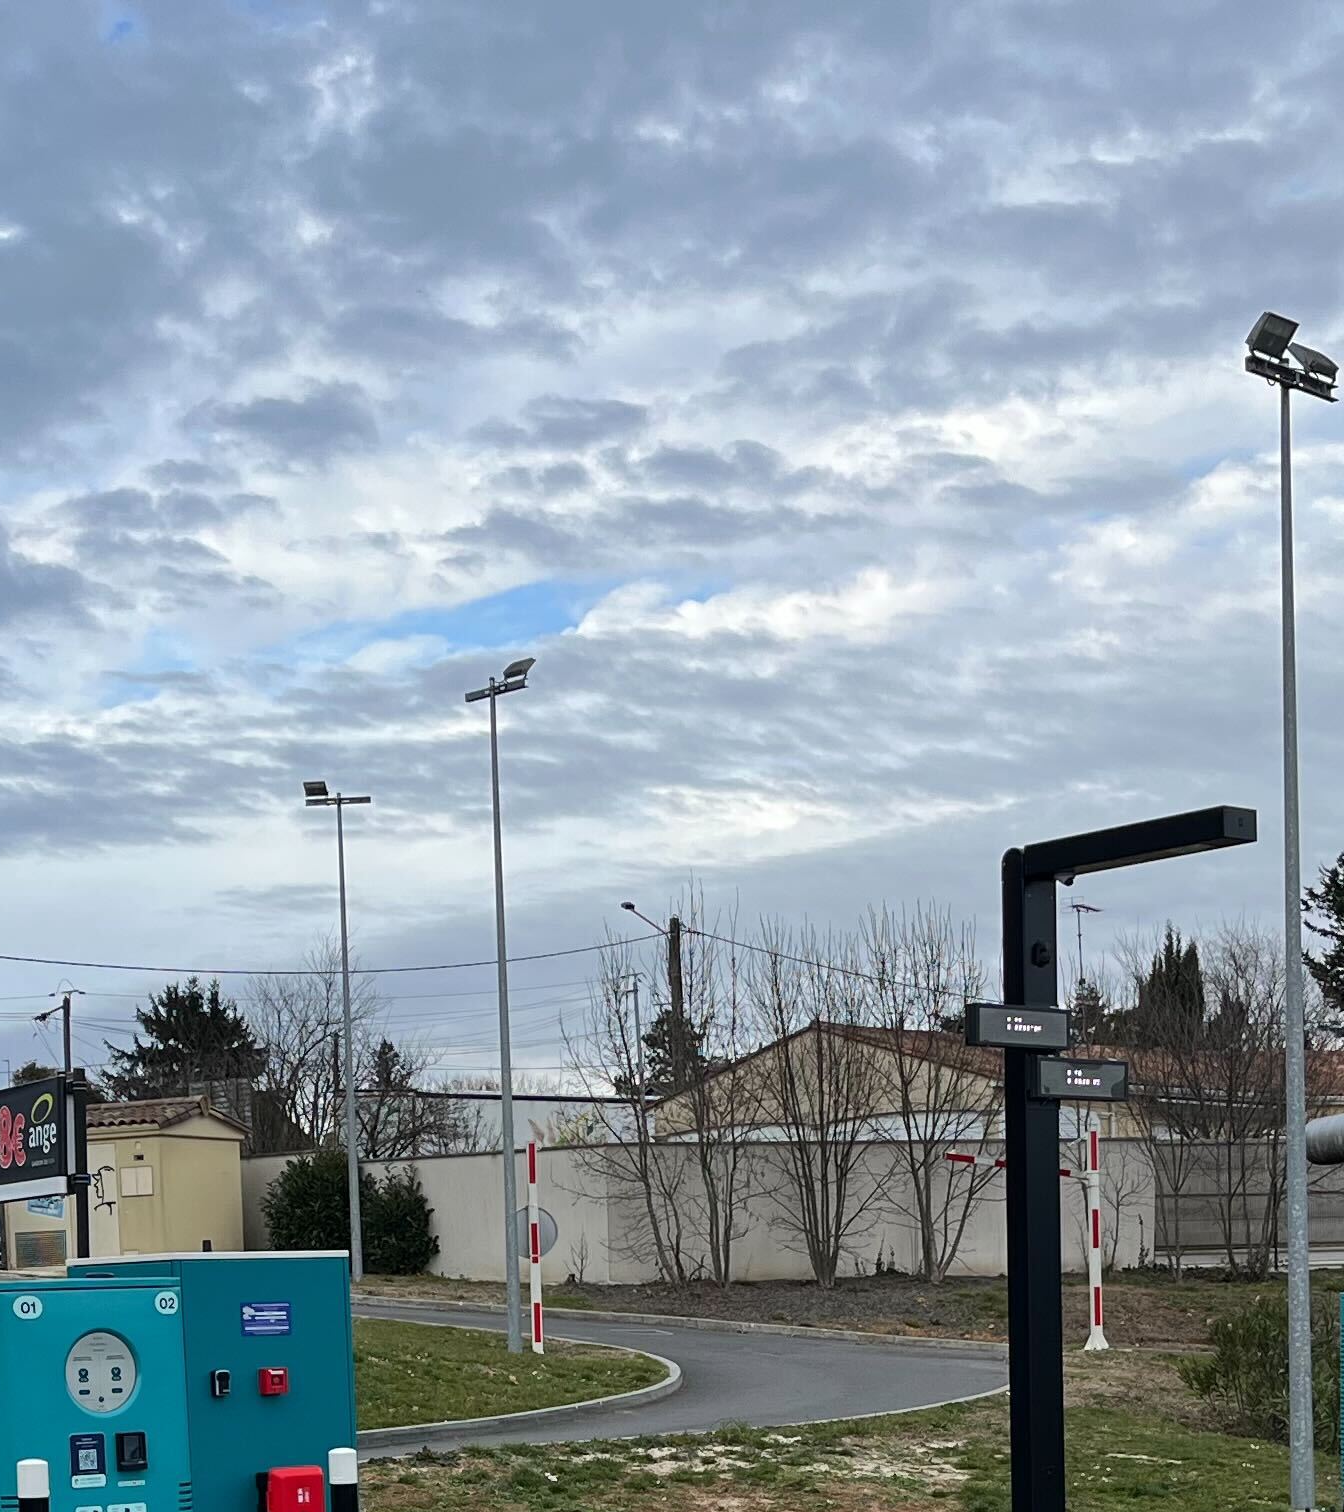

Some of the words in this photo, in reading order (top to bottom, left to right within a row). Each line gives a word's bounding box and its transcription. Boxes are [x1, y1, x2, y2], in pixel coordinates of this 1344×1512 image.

[28, 1122, 57, 1154] ange
[21, 1301, 37, 1314] 01
[159, 1297, 175, 1310] 02
